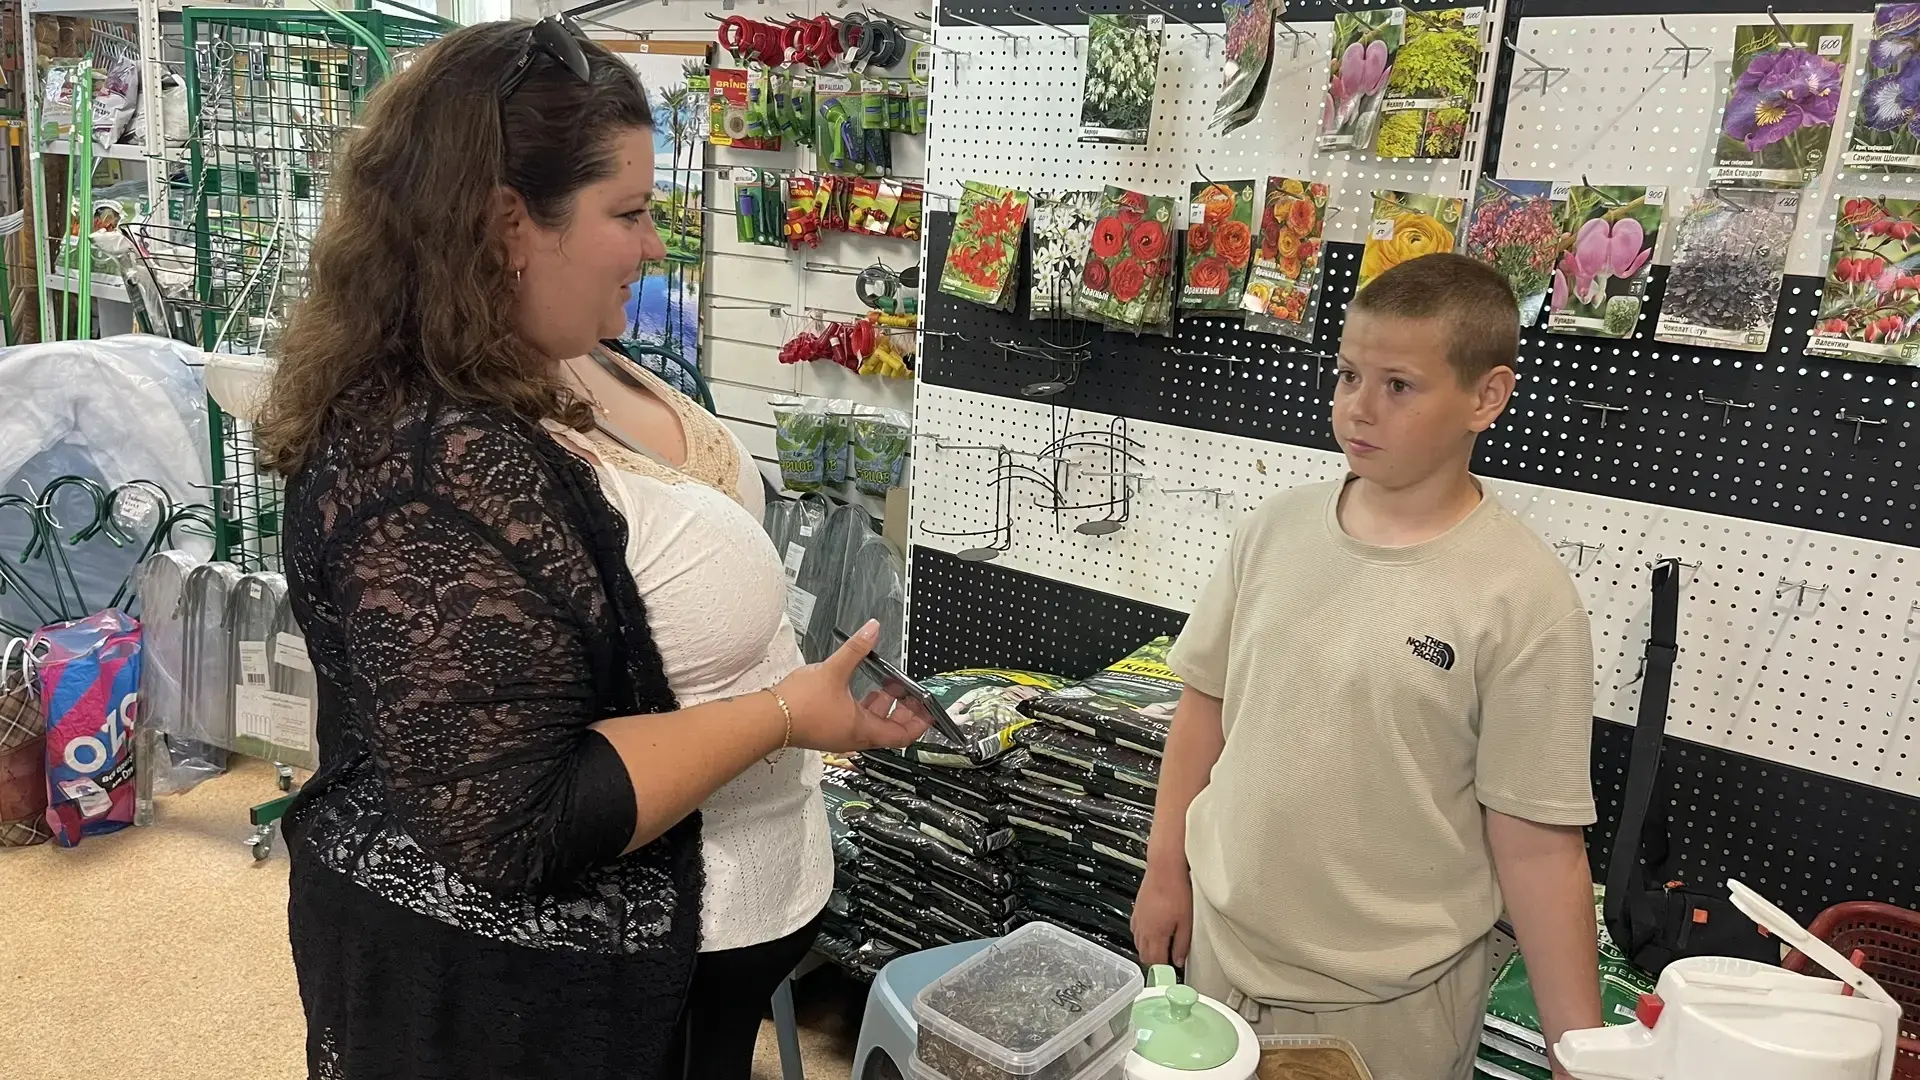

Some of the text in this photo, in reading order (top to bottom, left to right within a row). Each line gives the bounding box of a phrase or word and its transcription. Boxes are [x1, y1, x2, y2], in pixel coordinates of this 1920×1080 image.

[1820, 38, 1840, 50] 600
[1883, 154, 1910, 163] Шокинг
[1717, 169, 1762, 178] Дабл Стандарт
[1553, 186, 1569, 195] 1000
[1648, 190, 1663, 198] 900
[1081, 286, 1109, 300] Красный
[1184, 285, 1220, 296] Оранжевый
[1815, 338, 1849, 349] Валентина
[1406, 637, 1439, 655] NORTH
[1425, 635, 1444, 649] THE
[1412, 648, 1439, 665] FACE
